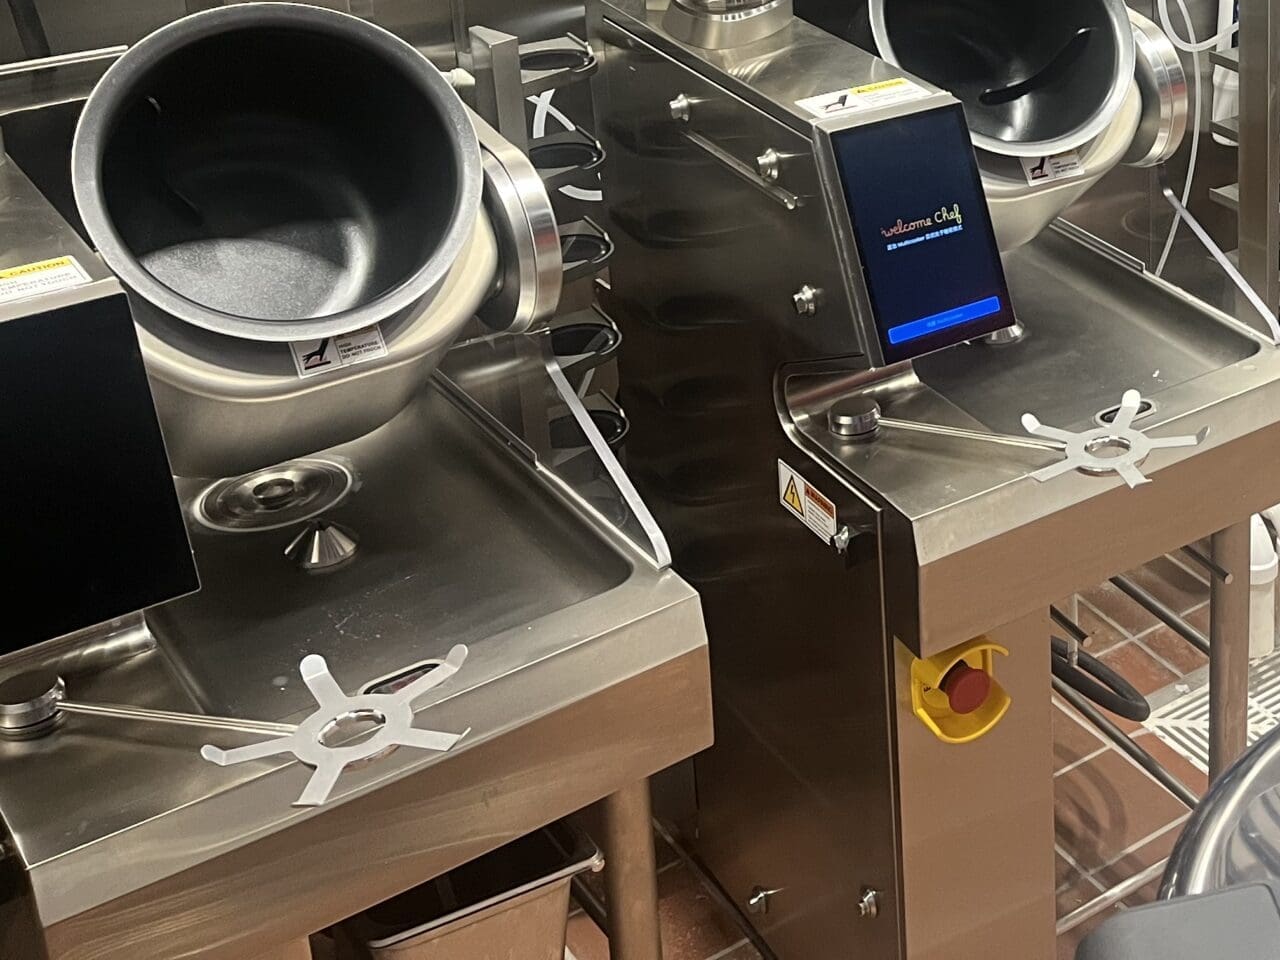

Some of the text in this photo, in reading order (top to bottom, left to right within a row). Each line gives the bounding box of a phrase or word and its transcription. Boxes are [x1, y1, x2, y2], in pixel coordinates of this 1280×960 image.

[881, 218, 933, 237] welcome
[934, 203, 963, 224] Chef
[10, 261, 65, 276] CAUTION
[0, 272, 71, 291] EMPERATURE
[340, 340, 378, 353] TEMPERATURE
